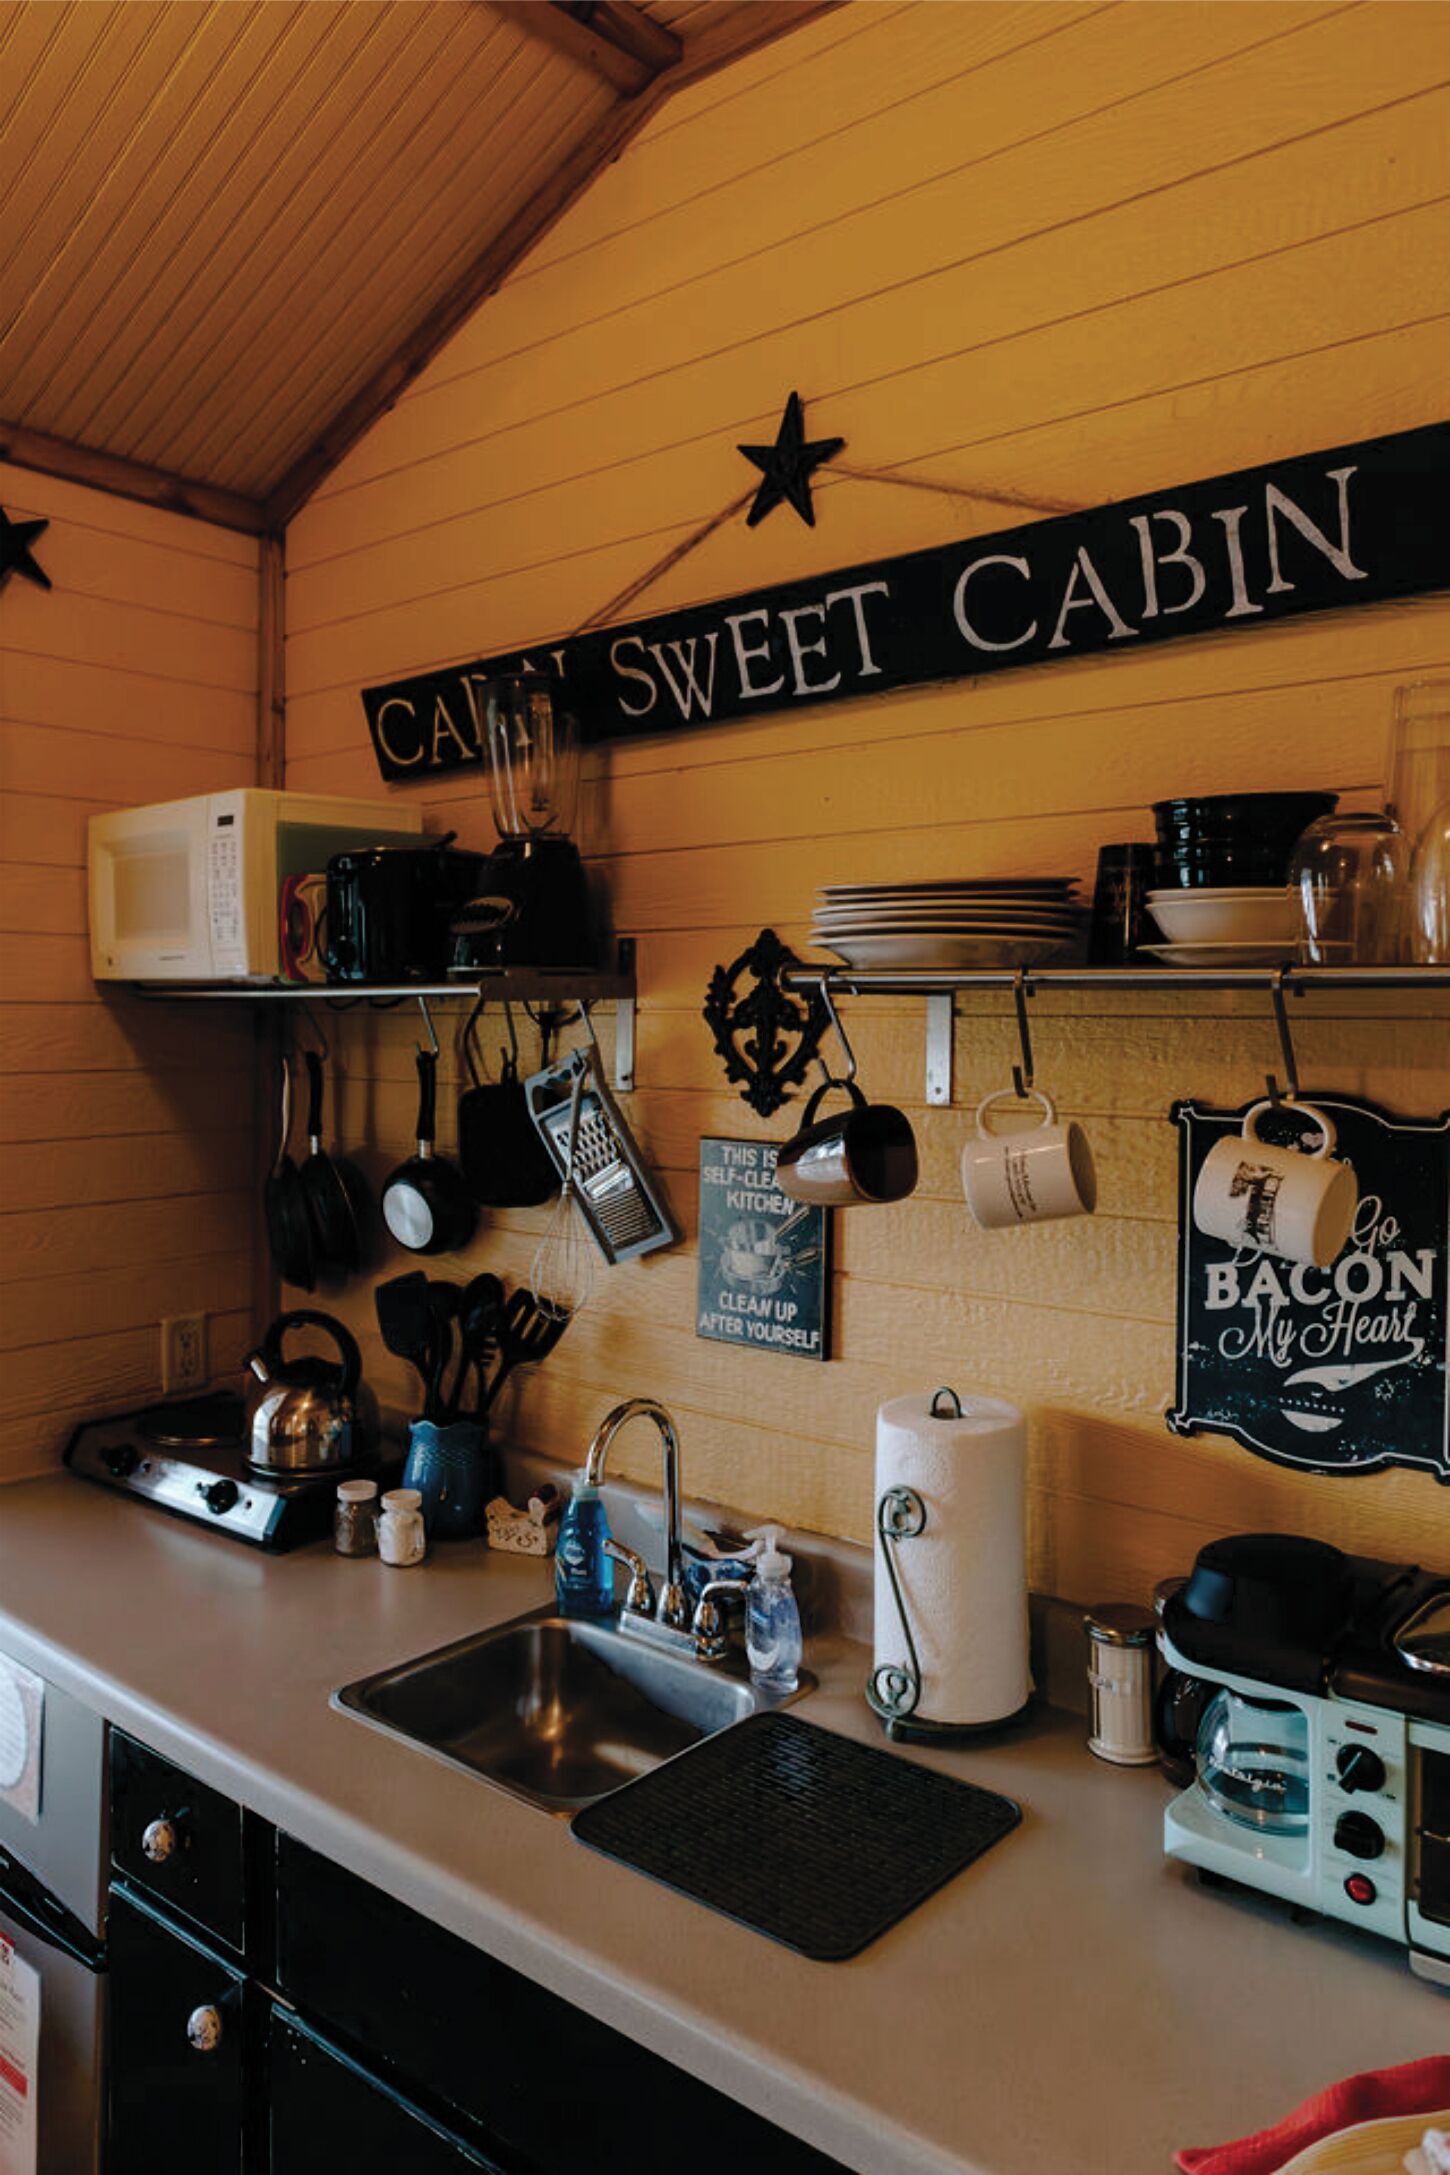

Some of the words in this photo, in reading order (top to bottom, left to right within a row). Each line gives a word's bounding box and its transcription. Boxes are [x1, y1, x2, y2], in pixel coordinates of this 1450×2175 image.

[610, 581, 889, 720] SWEET
[953, 466, 1368, 651] CABIN
[722, 1145, 757, 1168] THIS
[763, 1149, 779, 1169] IS
[726, 1189, 794, 1215] KITCHEN
[1351, 1195, 1400, 1257] Go
[1204, 1248, 1437, 1311] BACON
[699, 1312, 743, 1336] AFTER
[747, 1320, 820, 1349] YOURSELF
[719, 1291, 771, 1319] CLEAN
[775, 1301, 798, 1322] UP
[1218, 1299, 1297, 1368] My
[1300, 1299, 1424, 1358] Heart
